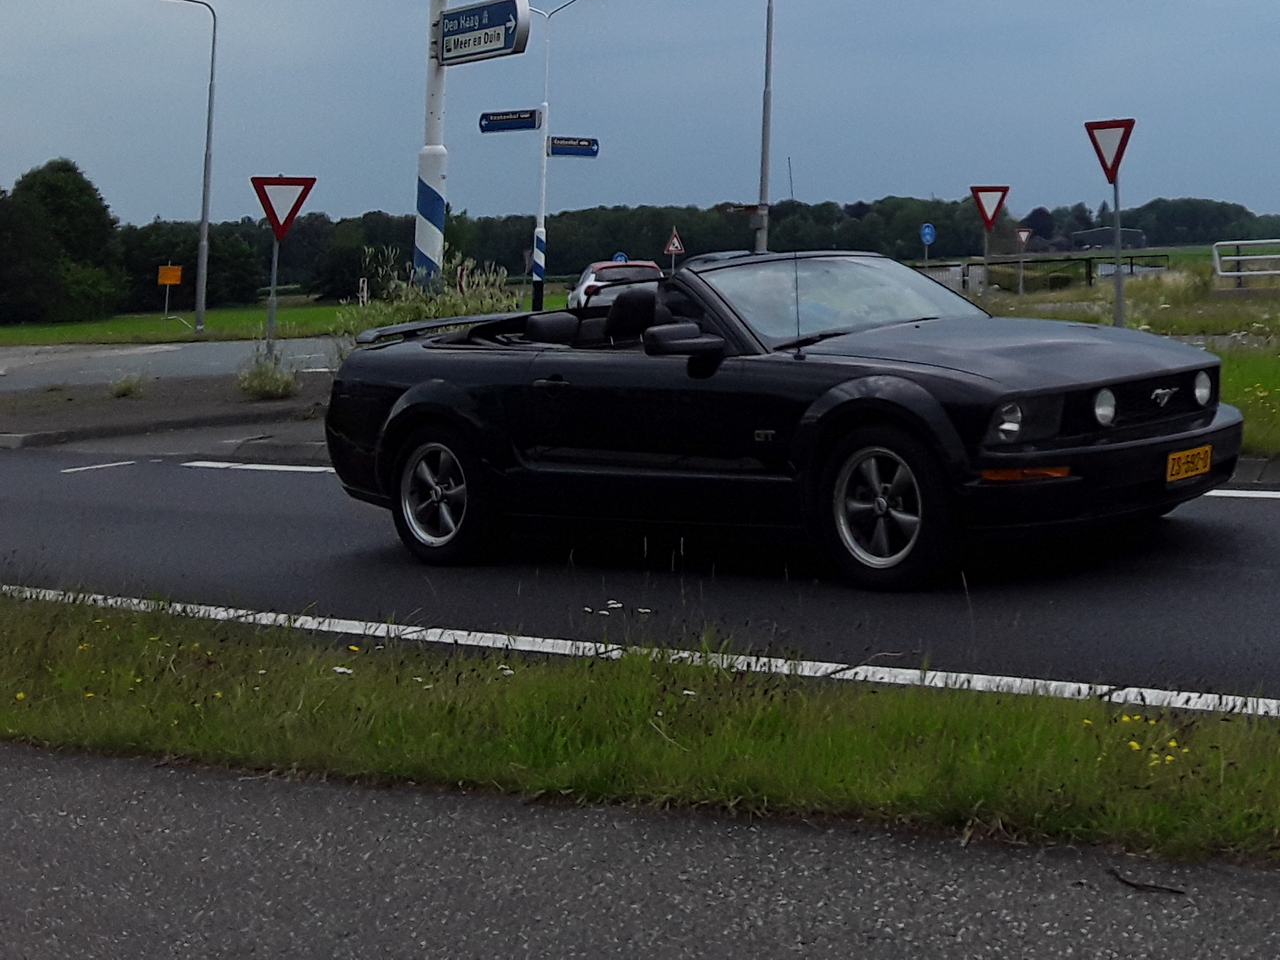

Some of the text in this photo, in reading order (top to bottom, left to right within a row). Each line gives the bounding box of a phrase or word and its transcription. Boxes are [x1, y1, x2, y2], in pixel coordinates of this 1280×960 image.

[444, 14, 479, 32] Den Haag
[453, 30, 501, 52] Meer en Duin
[754, 430, 776, 441] GT
